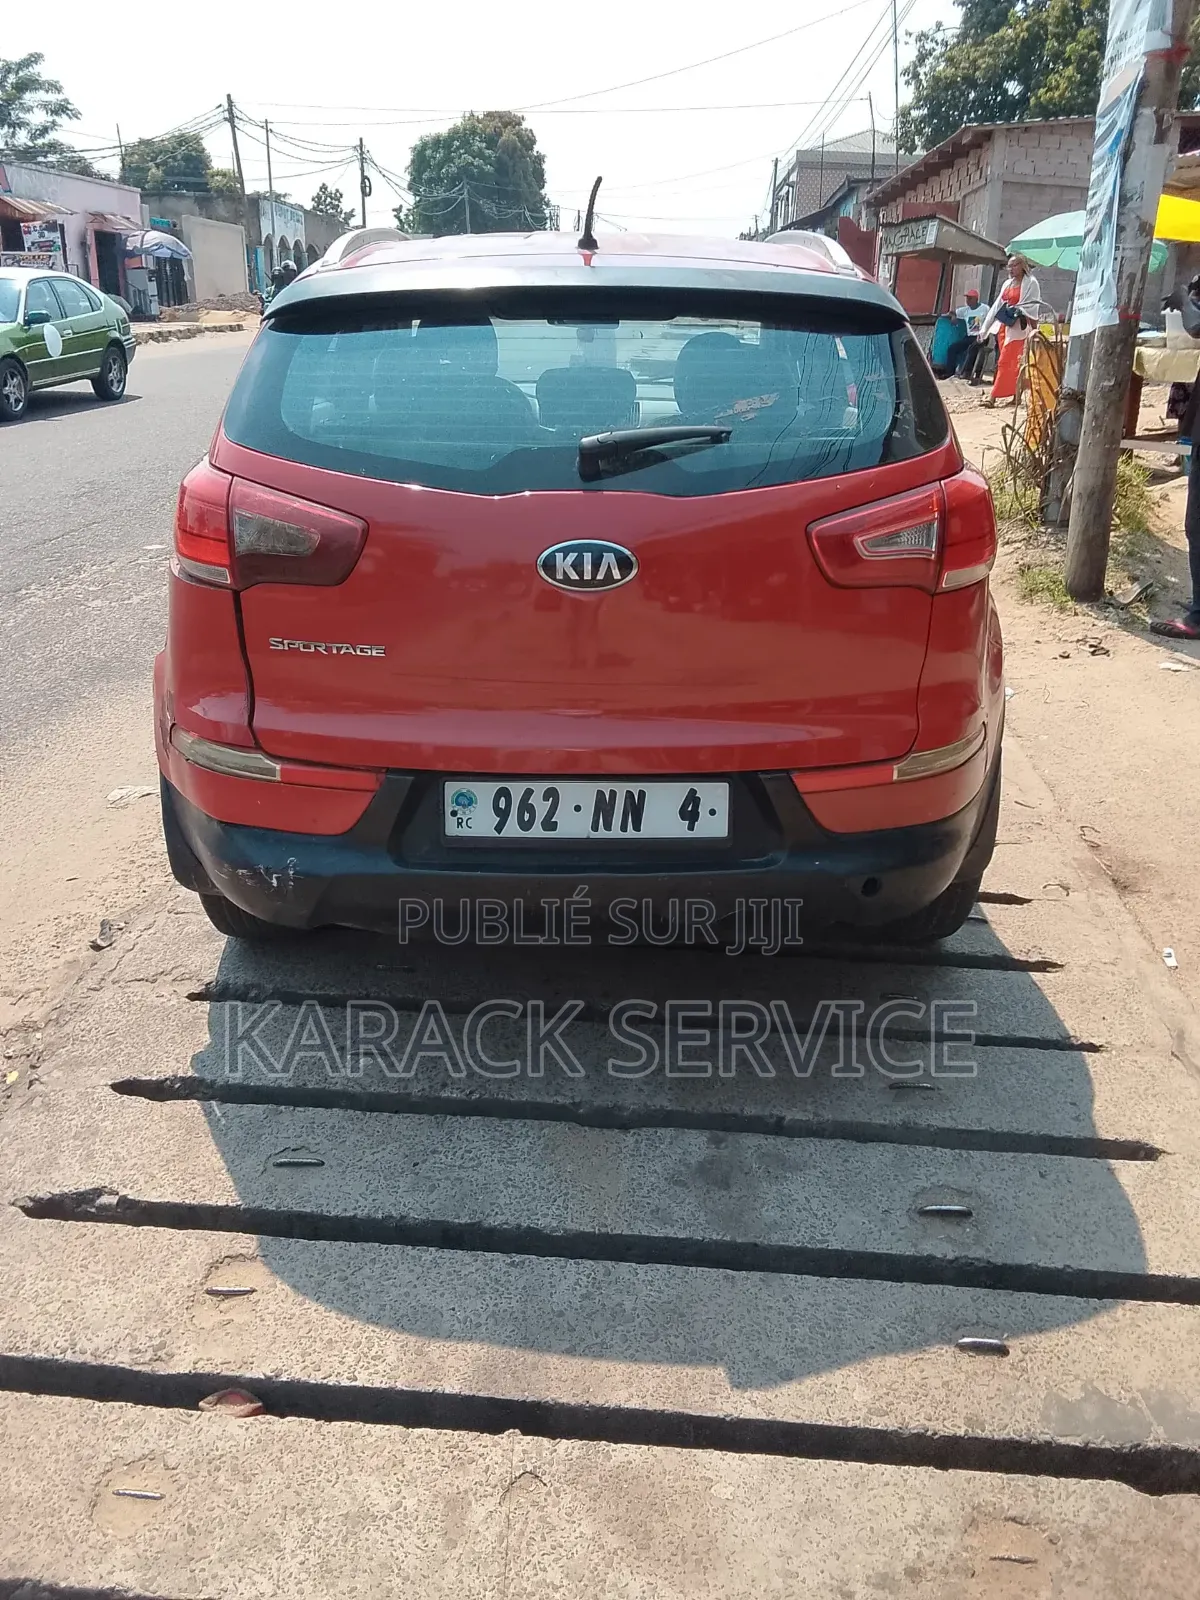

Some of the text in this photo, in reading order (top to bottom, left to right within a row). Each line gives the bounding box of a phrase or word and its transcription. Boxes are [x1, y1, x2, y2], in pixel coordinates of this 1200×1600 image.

[555, 552, 621, 580] KIA
[269, 637, 386, 657] SPORTAGE
[492, 786, 561, 834] 962
[591, 788, 647, 833] NN
[678, 787, 702, 832] 4
[456, 817, 473, 829] RC
